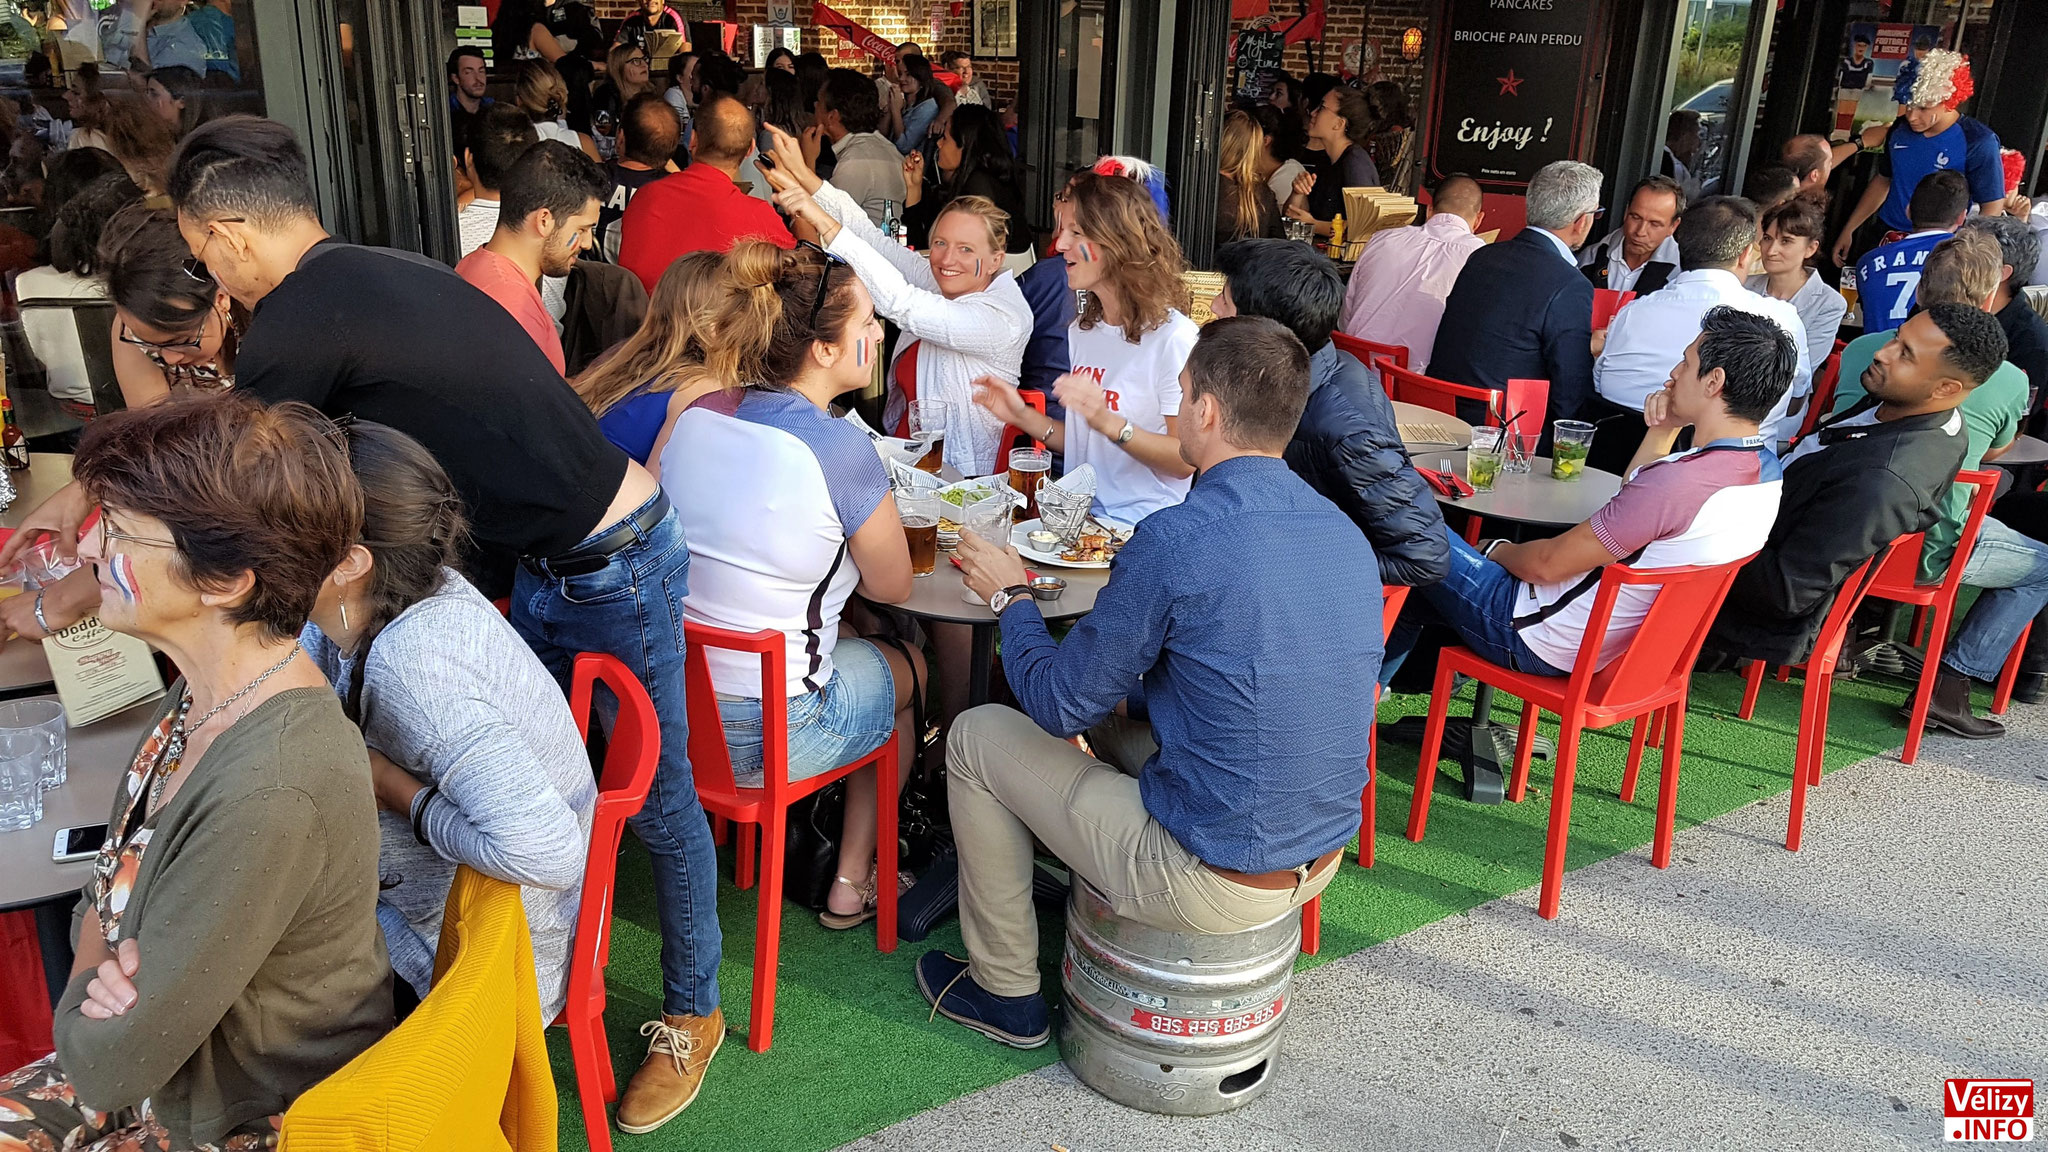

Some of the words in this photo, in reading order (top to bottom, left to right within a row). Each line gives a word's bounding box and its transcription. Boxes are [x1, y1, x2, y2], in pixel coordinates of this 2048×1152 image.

[1489, 0, 1553, 10] PANCAKES
[1240, 32, 1275, 58] Mojito
[1454, 30, 1506, 43] BRIOCHE
[1508, 32, 1538, 44] PAIN
[1541, 34, 1582, 46] PERDU
[1875, 37, 1908, 46] FOOTBALL
[1457, 117, 1533, 151] Enjoy
[1539, 117, 1553, 142] !
[1860, 250, 1930, 282] FRAN
[1886, 271, 1921, 319] 7
[1254, 1003, 1275, 1023] SEB
[1150, 1015, 1184, 1034] SEB
[1188, 1019, 1221, 1035] SEB
[1224, 1014, 1251, 1033] SEB
